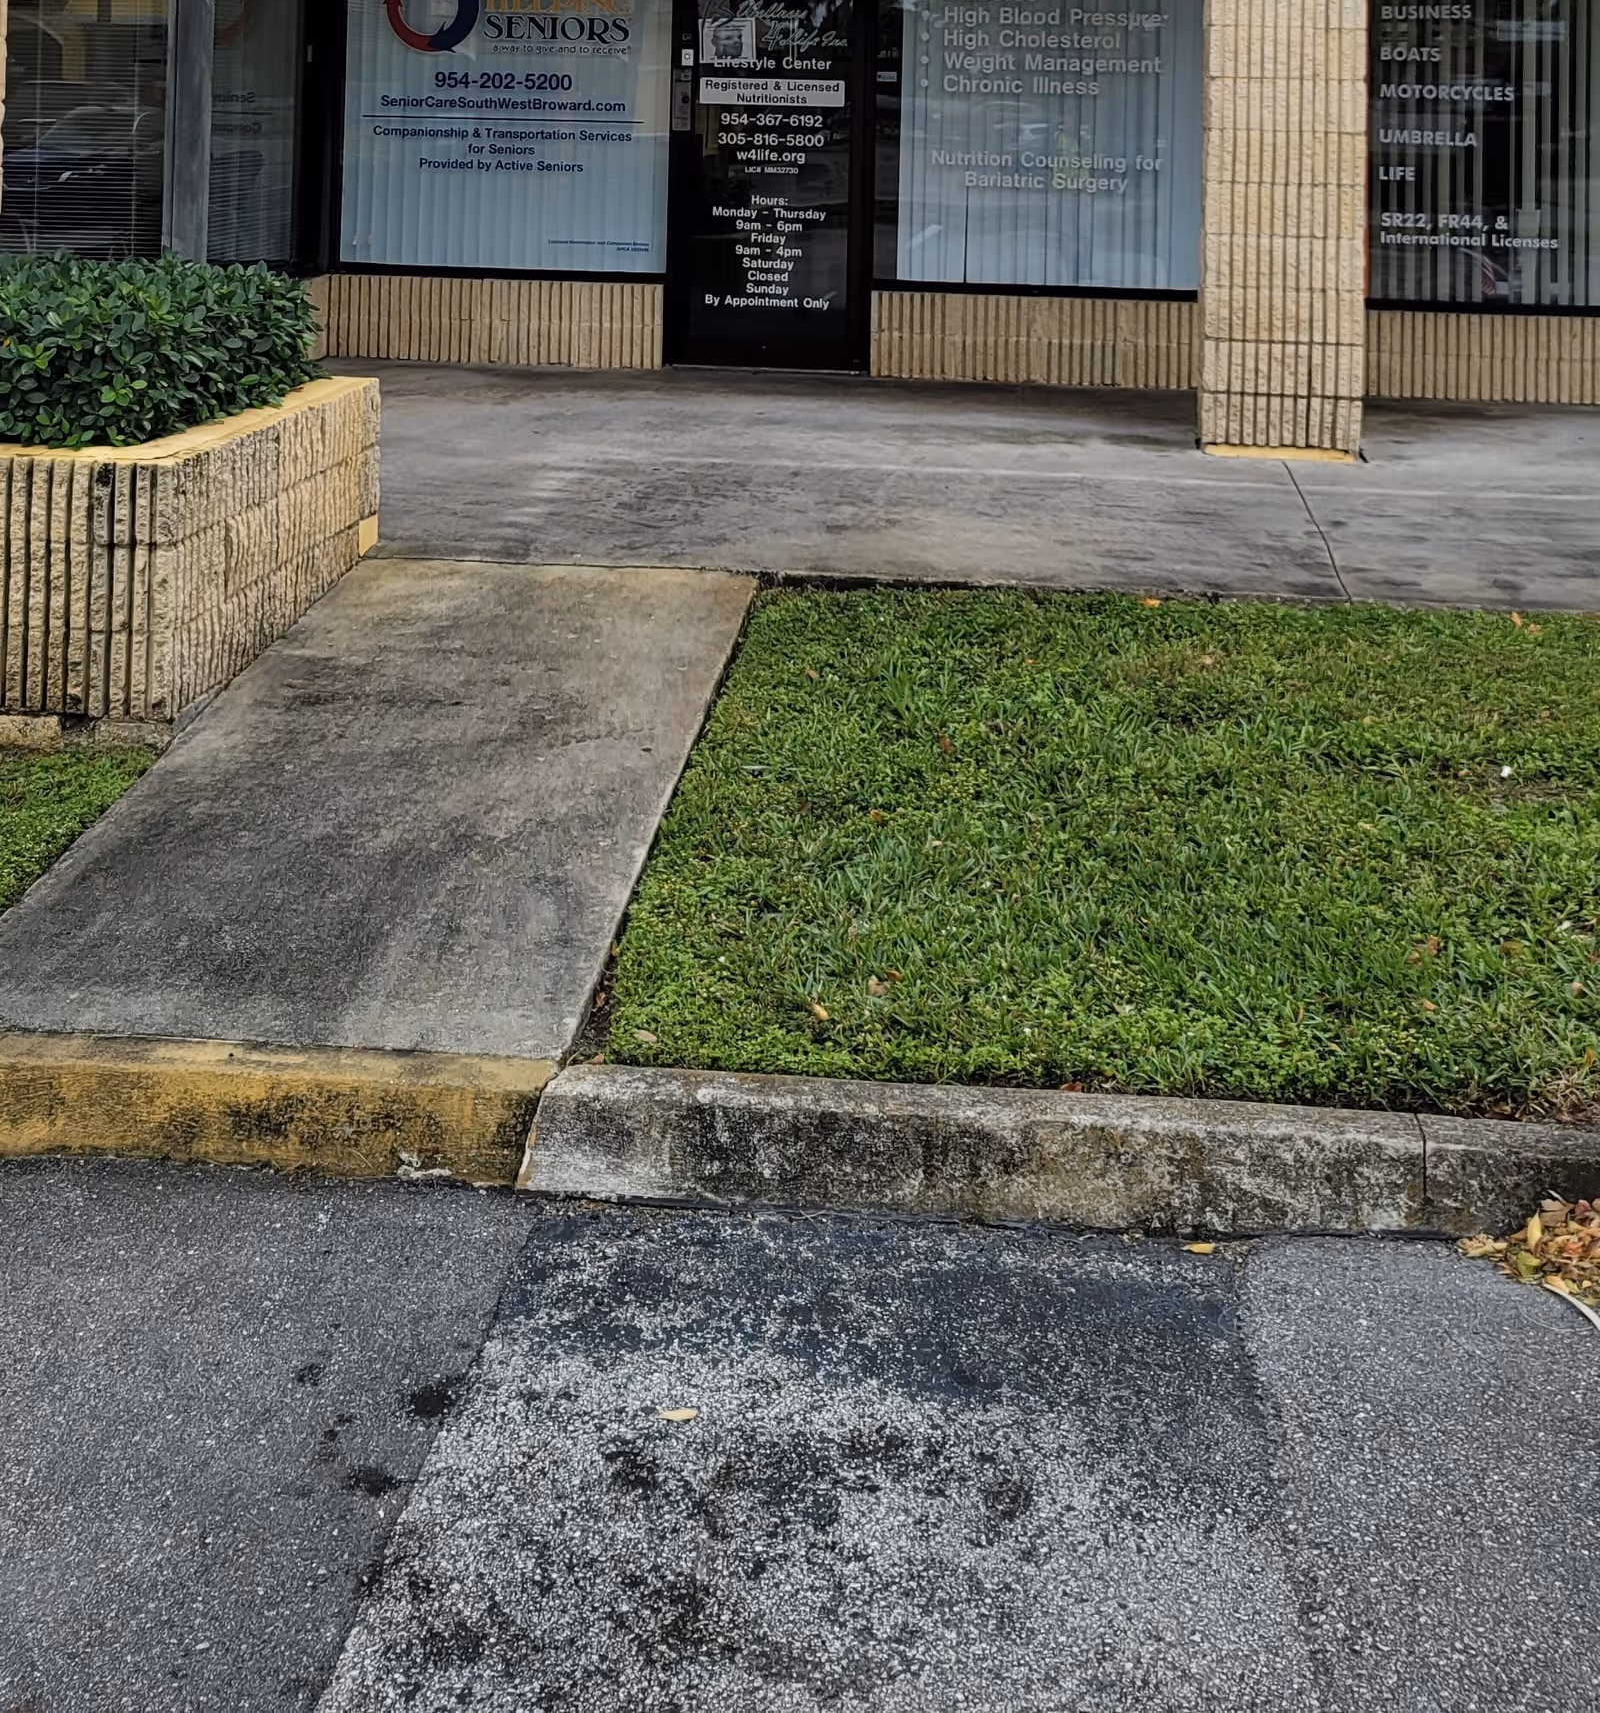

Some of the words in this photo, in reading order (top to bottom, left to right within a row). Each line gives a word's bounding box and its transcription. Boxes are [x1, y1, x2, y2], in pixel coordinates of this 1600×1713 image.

[944, 7, 990, 28] High
[1000, 8, 1060, 26] Blood
[1070, 10, 1163, 28] Pressure
[1381, 5, 1472, 20] BUSINESS
[484, 14, 630, 44] SENIORS
[943, 30, 990, 49] High
[999, 31, 1120, 49] Cholesterol
[502, 45, 520, 54] way
[537, 45, 554, 54] give
[558, 45, 576, 53] and
[1380, 47, 1442, 62] BOATS
[714, 56, 776, 71] Lifestyle
[782, 57, 832, 70] Center
[944, 54, 1015, 74] Weight
[1025, 55, 1162, 75] Management
[434, 71, 573, 91] 954-202-5200
[705, 80, 768, 91] Registered
[773, 81, 782, 91] &
[787, 81, 840, 92] Licensed
[943, 76, 1023, 93] Chronic
[1033, 77, 1100, 95] Illness
[737, 94, 807, 104] Nutritionists
[1379, 83, 1515, 101] MOTORCYCLES
[380, 95, 626, 112] SeniorCareSouthWestBroward.com
[721, 113, 823, 127] 954-367-6192
[373, 125, 469, 141] Companionship
[472, 128, 482, 138] &
[485, 128, 576, 144] Transportation
[579, 130, 632, 142] Services
[718, 132, 825, 147] 305-816-5800
[1379, 129, 1477, 147] UMBRELLA
[468, 144, 485, 155] for
[489, 144, 535, 155] Seniors
[736, 149, 806, 164] w4life.org
[419, 158, 474, 170] Provided
[477, 159, 492, 172] by
[496, 160, 533, 171] Active
[537, 161, 584, 173] Seniors
[932, 150, 1012, 167] Nutrition
[1020, 151, 1127, 173] Counseling
[1135, 155, 1164, 171] for
[1379, 166, 1416, 181] LIFE
[964, 171, 1044, 189] Bariatric
[1052, 173, 1128, 193] Surgery
[751, 195, 789, 206] Hours:
[712, 206, 758, 219] Monday
[773, 208, 826, 221] Thursday
[736, 220, 761, 231] 9am
[776, 221, 803, 233] 6pm
[1381, 213, 1432, 230] SR22,
[1438, 214, 1488, 231] FR44,
[1495, 216, 1508, 230] &
[751, 233, 786, 246] Friday
[1380, 231, 1486, 247] International
[1491, 233, 1559, 249] Licenses
[735, 245, 761, 255] 9am
[776, 246, 802, 258] 4pm
[742, 258, 794, 270] Saturday
[747, 271, 789, 282] Closed
[746, 283, 789, 296] Sunday
[705, 295, 720, 306] By
[724, 295, 799, 307] Appointment
[803, 298, 830, 310] Only
